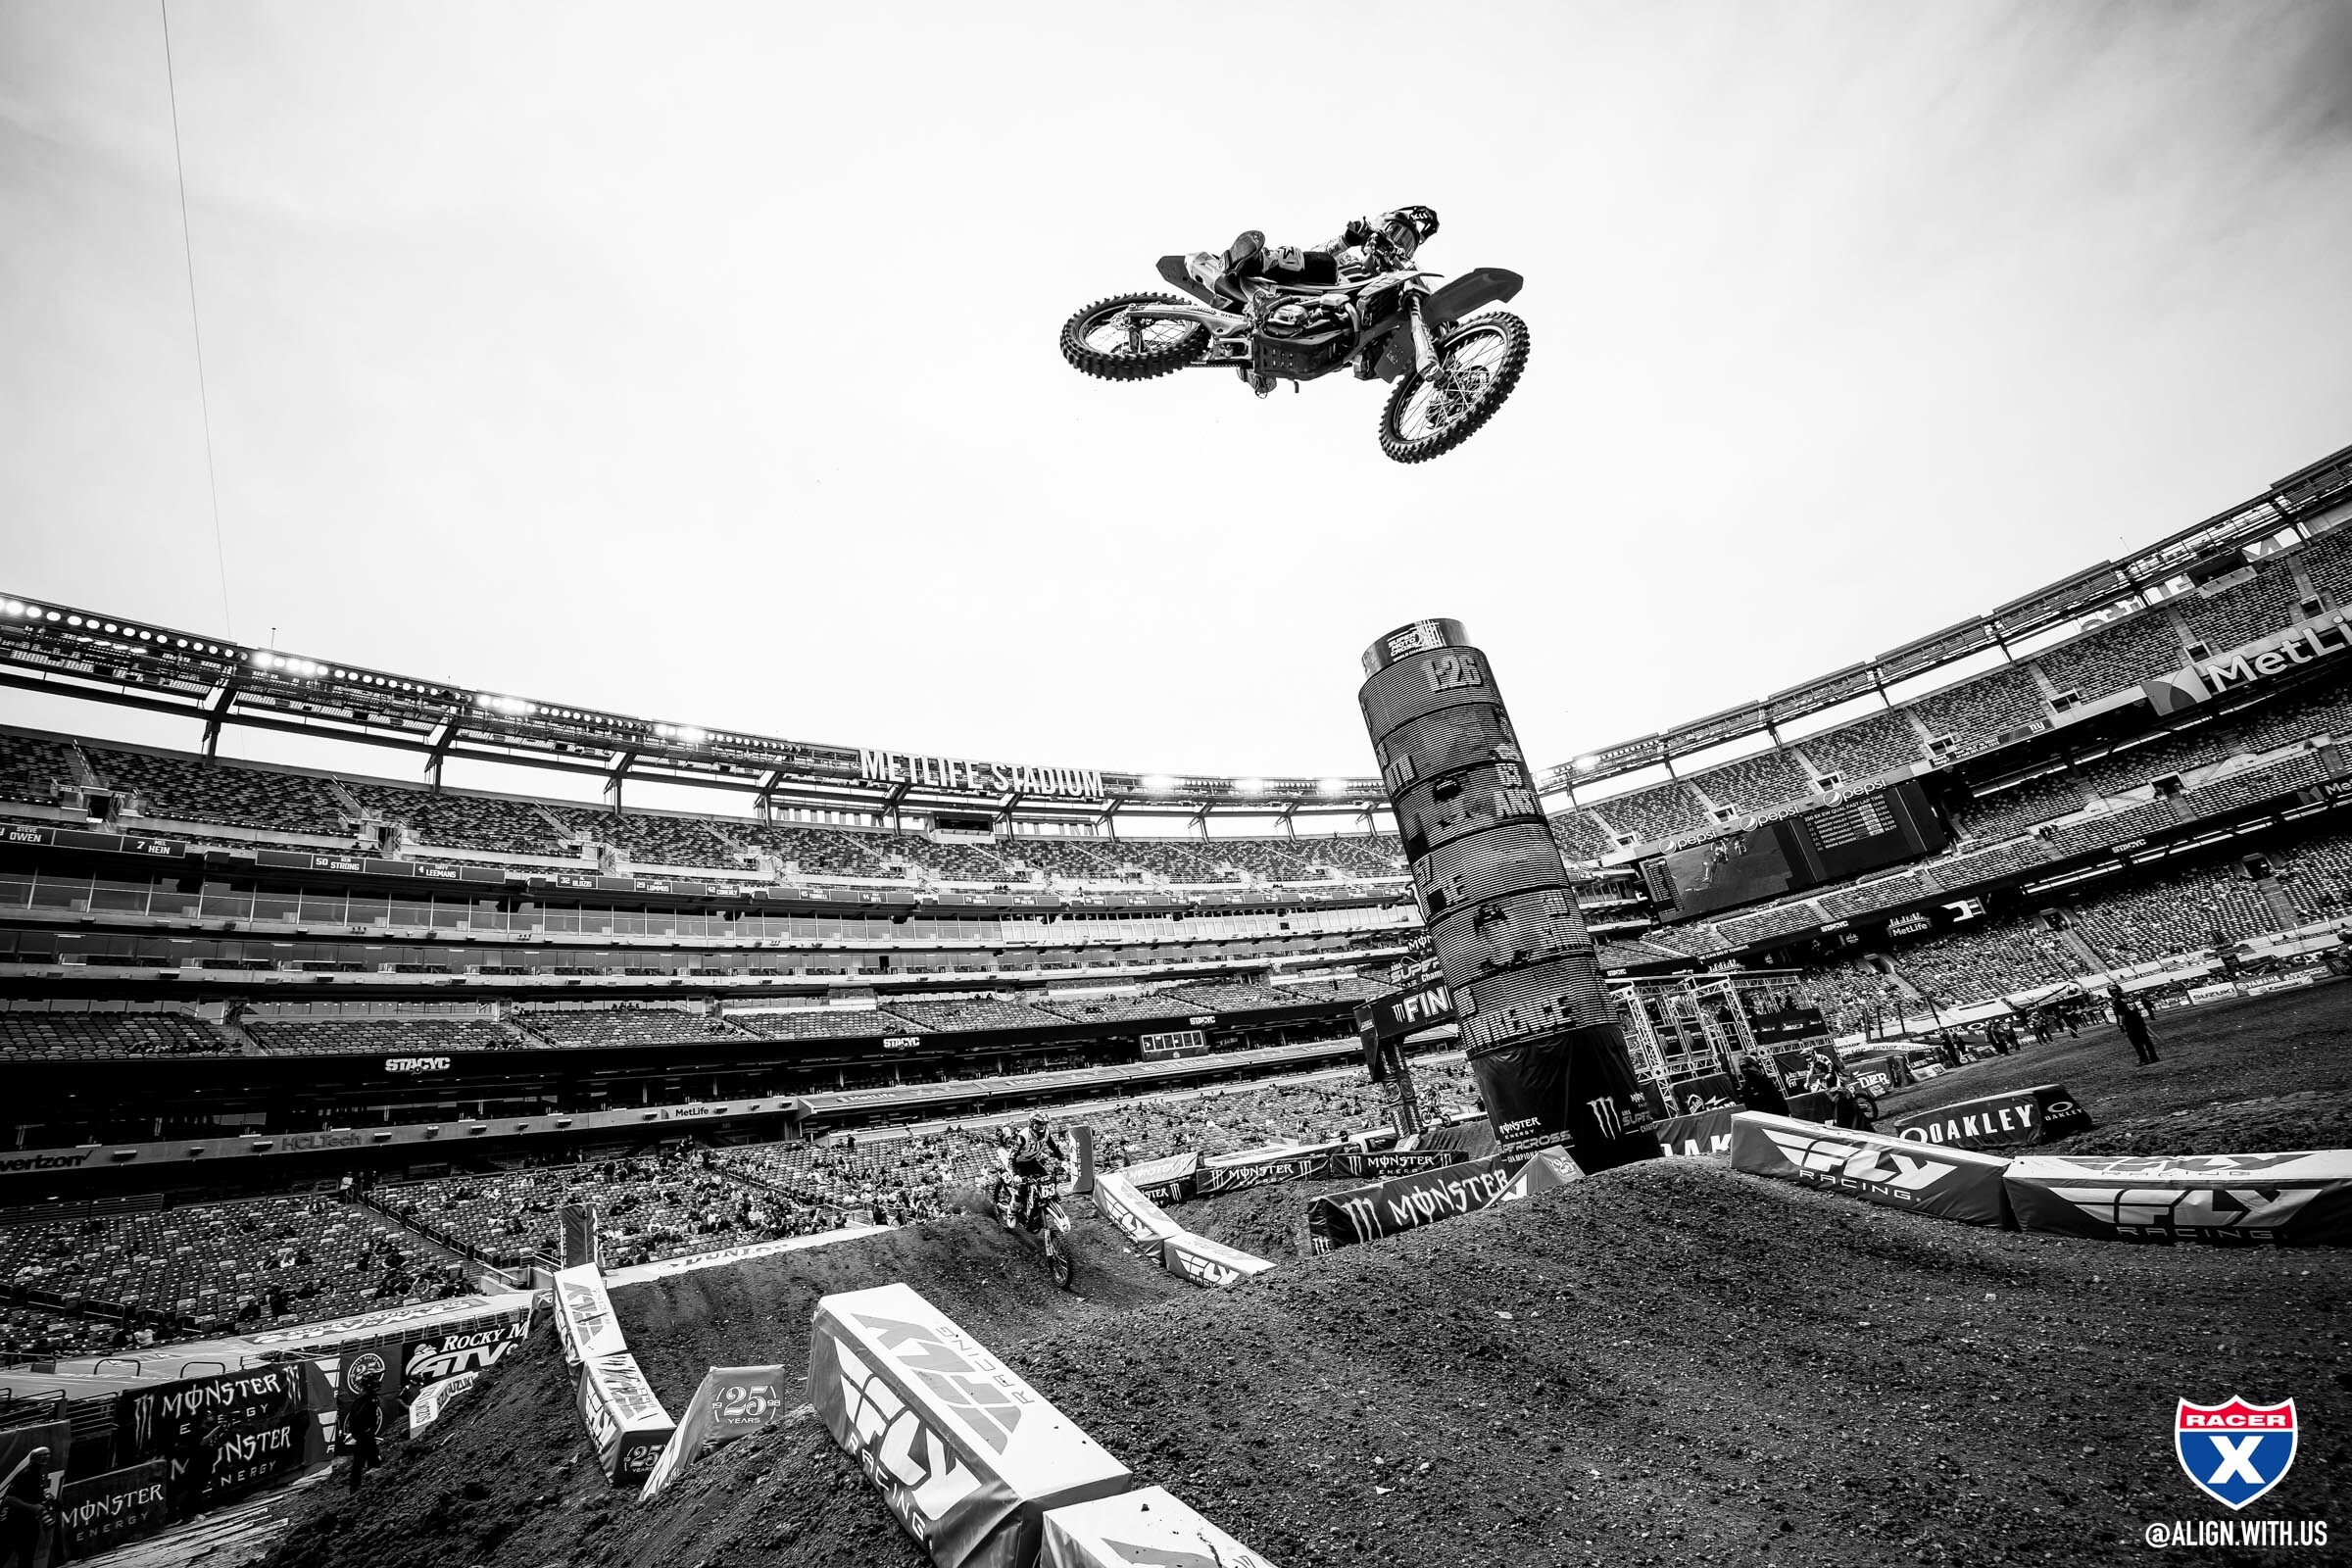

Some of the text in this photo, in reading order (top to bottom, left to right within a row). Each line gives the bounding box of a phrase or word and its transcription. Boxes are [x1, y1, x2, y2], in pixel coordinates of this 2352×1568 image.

[1388, 632, 1416, 648] SUPER
[1391, 637, 1416, 652] MOTO
[2206, 616, 2352, 692] MetLi
[858, 748, 1105, 798] METLIFE STADIUM
[1842, 778, 1887, 803] pepsi
[1757, 804, 1800, 828] pepsi
[9, 833, 42, 843] OWEN
[136, 841, 145, 850] 7
[1678, 830, 1717, 850] pepsi
[2110, 838, 2147, 854] STACYC
[148, 845, 171, 855] HEIN
[330, 861, 361, 871] STRONG
[425, 869, 457, 878] LEEMANS
[1892, 923, 1928, 936] MetLife
[2246, 976, 2281, 989] YAMAHA
[1403, 986, 1450, 1022] FIN
[2192, 988, 2235, 1002] SUZUKI
[1189, 1015, 1216, 1026] STACYC
[883, 1037, 921, 1049] STACYC
[384, 1056, 451, 1074] STACYC
[675, 1104, 710, 1117] MetLife
[2044, 1107, 2083, 1121] OAKLEY
[1505, 1128, 1535, 1139] ENERGY
[1929, 1103, 2034, 1144] OAKLEY
[282, 1132, 363, 1152] HCLTech
[0, 1152, 84, 1172] verizon
[1367, 1154, 1435, 1168] MONSTER
[1761, 1129, 1958, 1190] FLY
[1228, 1162, 1295, 1180] MONSTER
[1799, 1170, 1912, 1200] RACING
[1388, 1169, 1509, 1227] MONSTER
[2048, 1187, 2323, 1227] FLY
[2116, 1226, 2273, 1240] RACING
[1175, 1249, 1241, 1286] FLY
[440, 1328, 506, 1352] ROCKY
[935, 1326, 1036, 1405] RACING
[161, 1373, 282, 1419] MONSTER
[723, 1386, 769, 1417] 25
[834, 1336, 982, 1520] FLY
[171, 1426, 292, 1481] MNSTER
[630, 1446, 662, 1467] 25
[202, 1460, 276, 1494] NERGY
[848, 1430, 927, 1542] RACING
[61, 1484, 165, 1529] MONSTER
[76, 1512, 149, 1542] ENERGY
